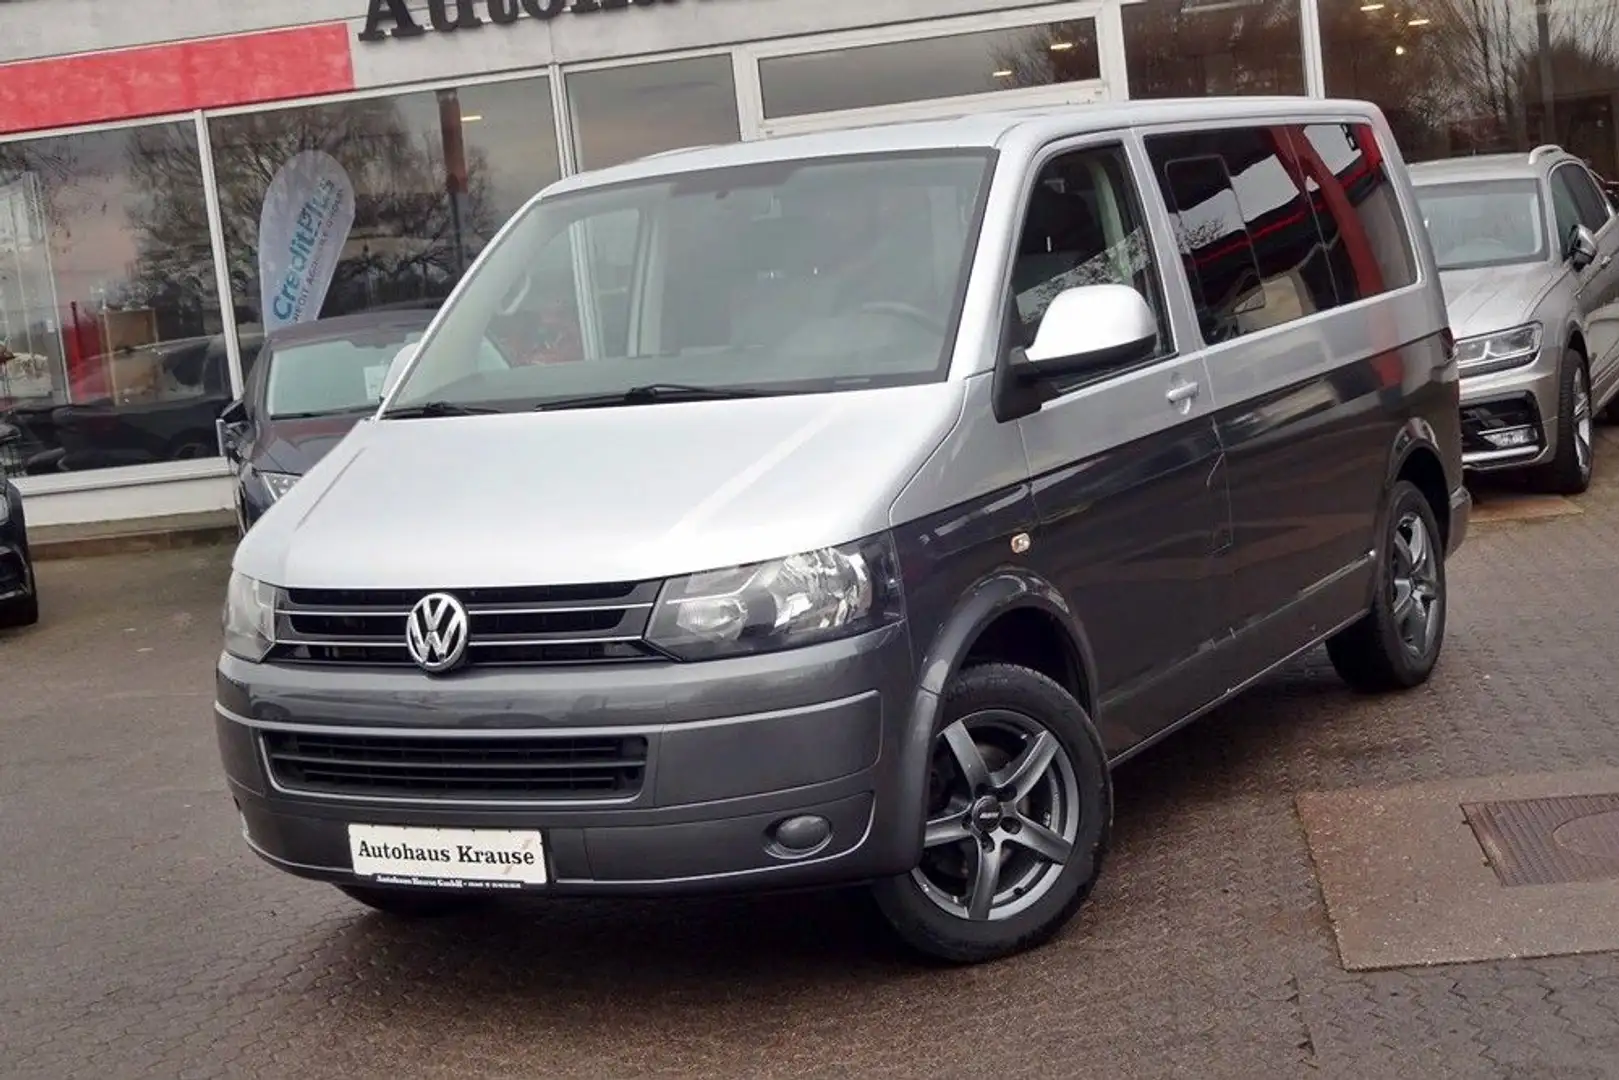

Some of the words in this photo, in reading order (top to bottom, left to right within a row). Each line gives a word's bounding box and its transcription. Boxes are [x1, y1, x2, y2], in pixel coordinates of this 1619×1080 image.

[272, 179, 335, 321] CreditPlus
[358, 840, 450, 862] Autohaus
[456, 845, 535, 865] Krause
